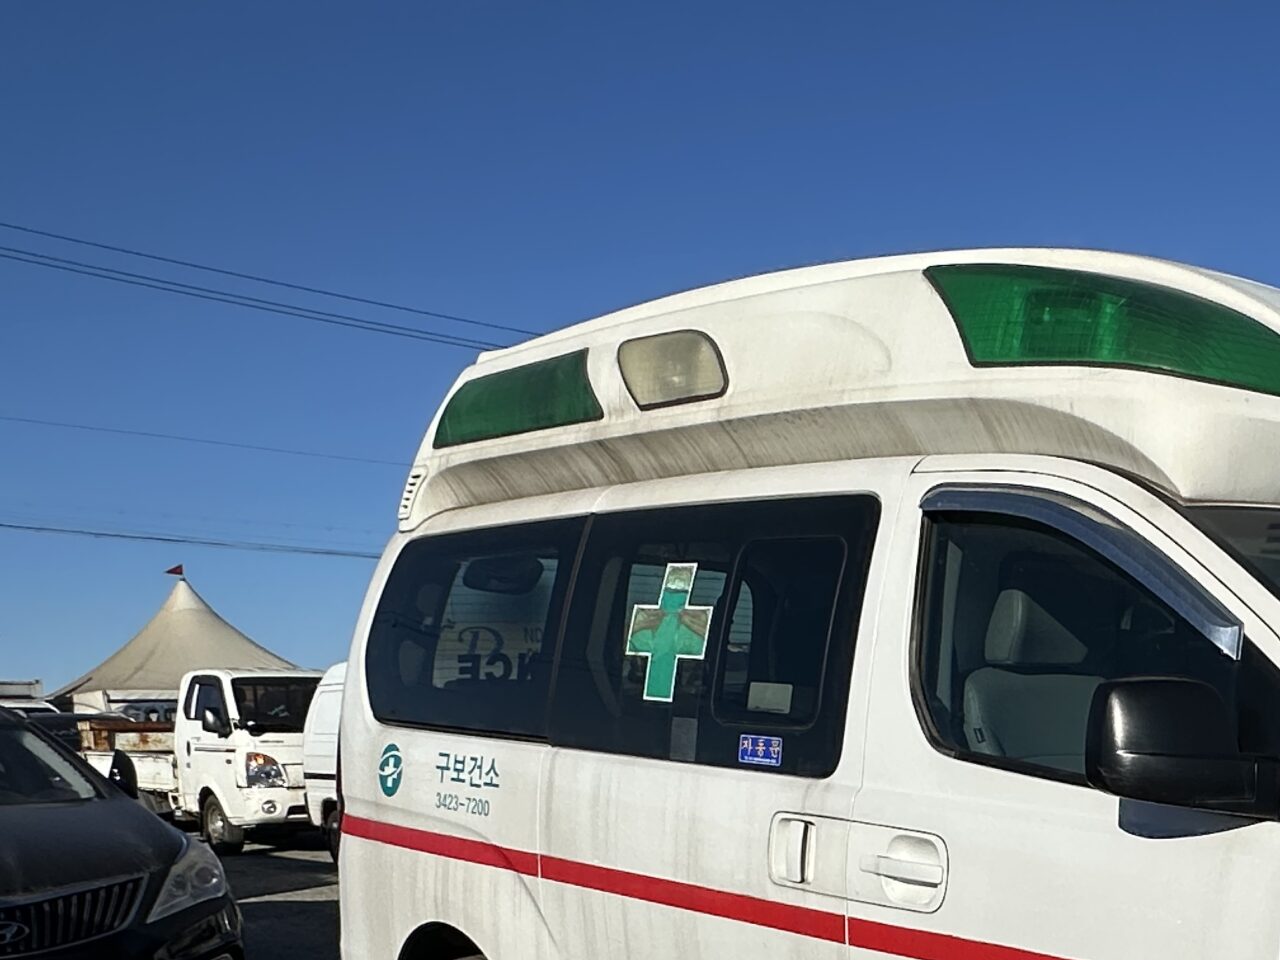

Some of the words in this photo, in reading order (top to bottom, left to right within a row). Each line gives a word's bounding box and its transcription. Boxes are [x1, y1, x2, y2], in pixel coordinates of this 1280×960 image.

[742, 738, 780, 758] 자동문
[435, 752, 500, 788] 구보건소
[435, 793, 489, 817] 3423-7200
